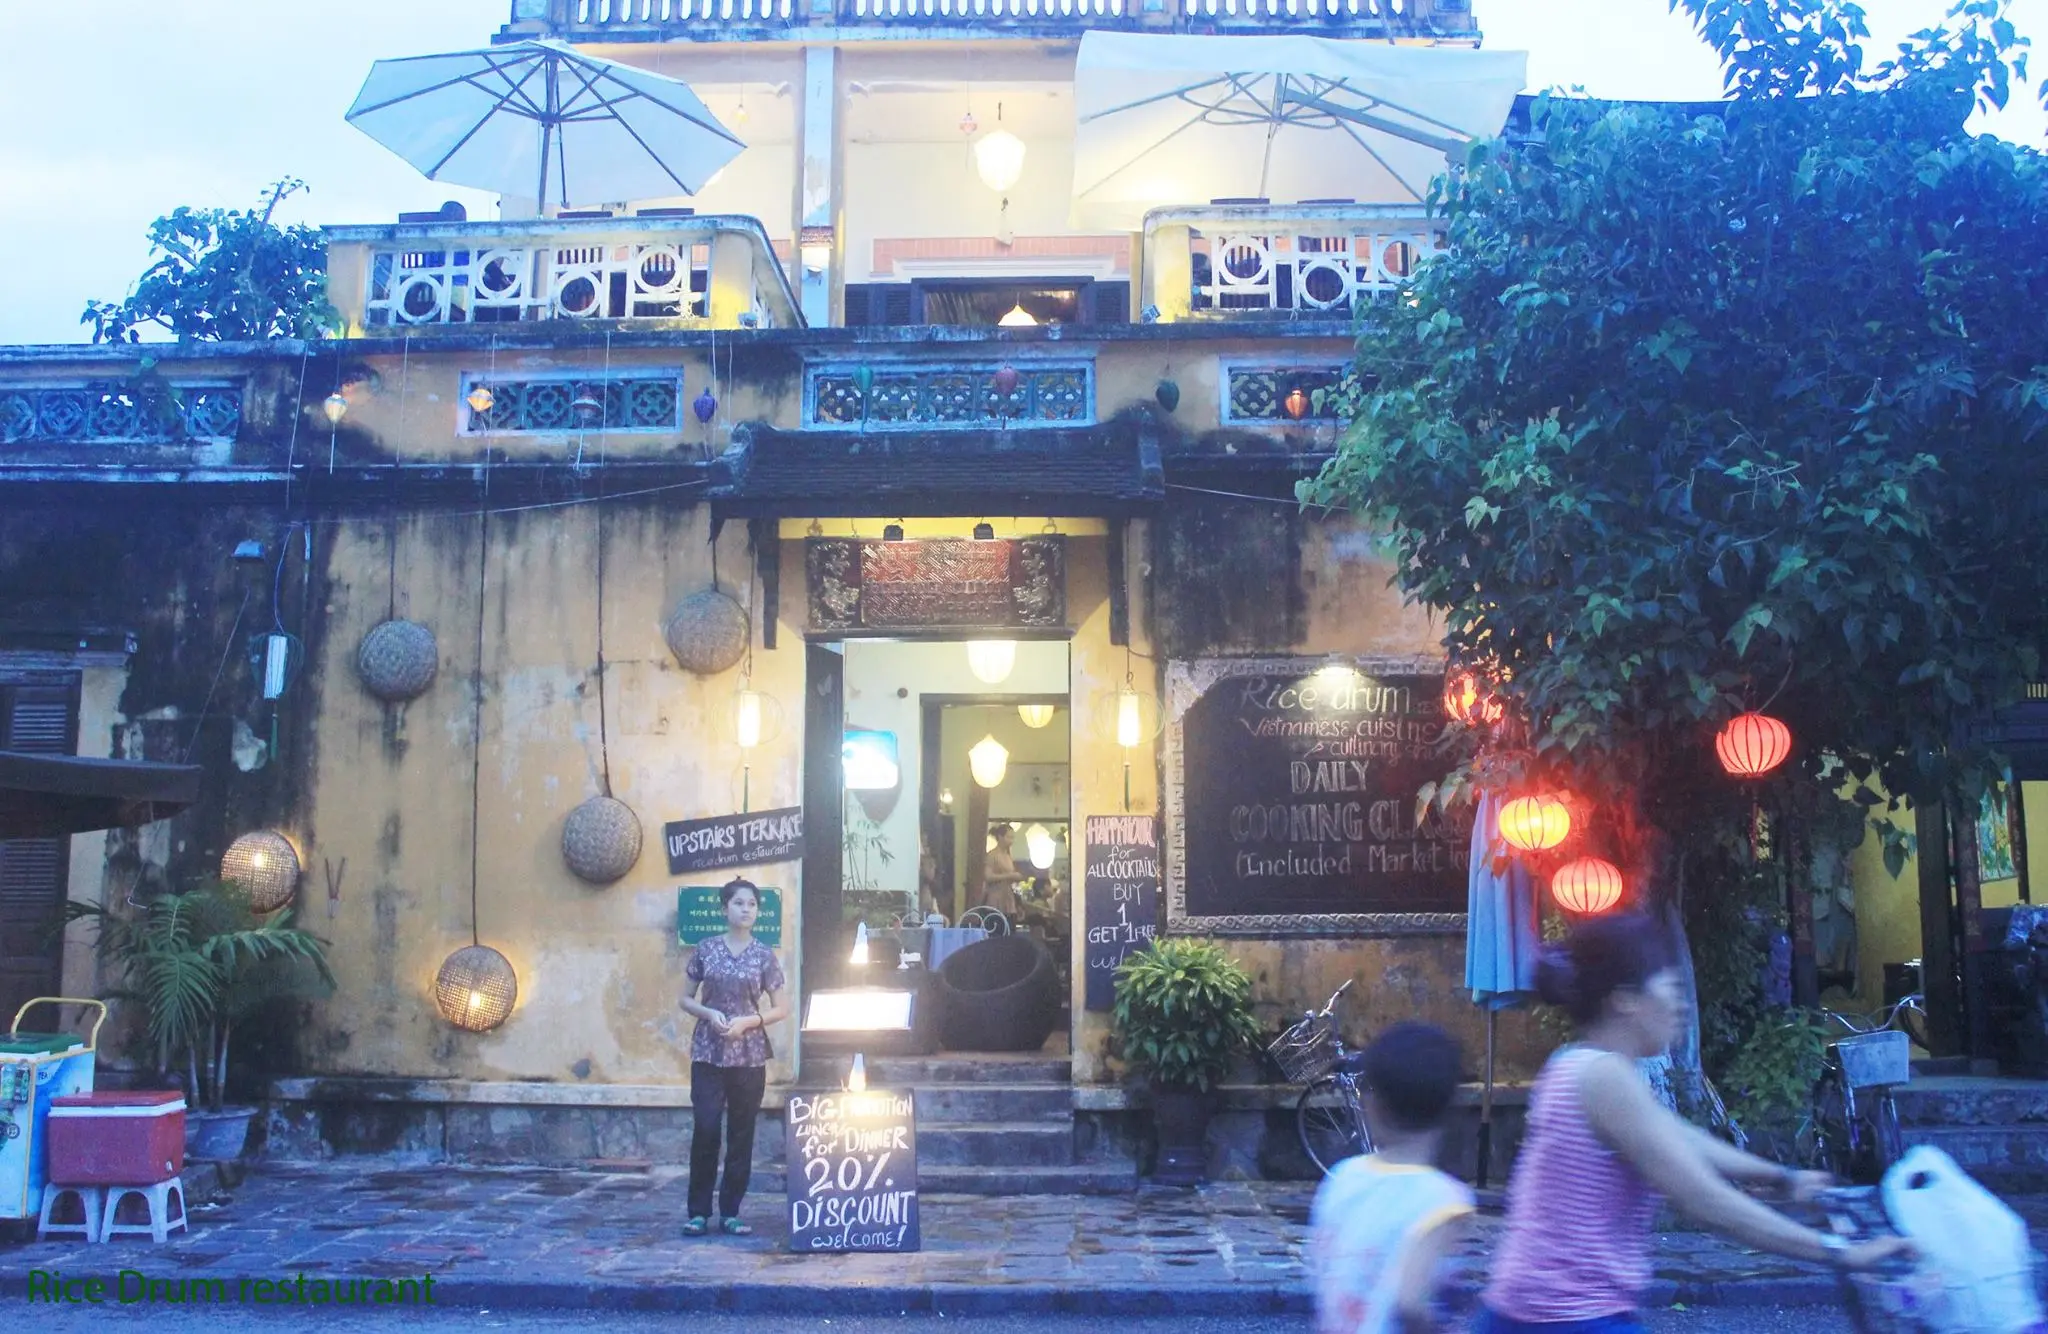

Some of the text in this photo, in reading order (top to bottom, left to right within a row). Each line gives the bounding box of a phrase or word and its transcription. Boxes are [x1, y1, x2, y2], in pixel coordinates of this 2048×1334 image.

[1241, 678, 1318, 710] Rice
[1330, 679, 1411, 714] drum
[1290, 760, 1370, 793] DAILY
[1229, 801, 1364, 842] COOKING
[1107, 846, 1136, 862] for
[1368, 841, 1444, 874] Market
[1087, 864, 1107, 878] ALL
[1113, 882, 1144, 906] BUY
[1116, 902, 1130, 927] 1
[1088, 925, 1120, 943] GET
[1123, 922, 1137, 943] 1
[839, 1093, 914, 1119] POTION
[801, 1135, 839, 1160] for
[803, 1151, 895, 1197] 20%
